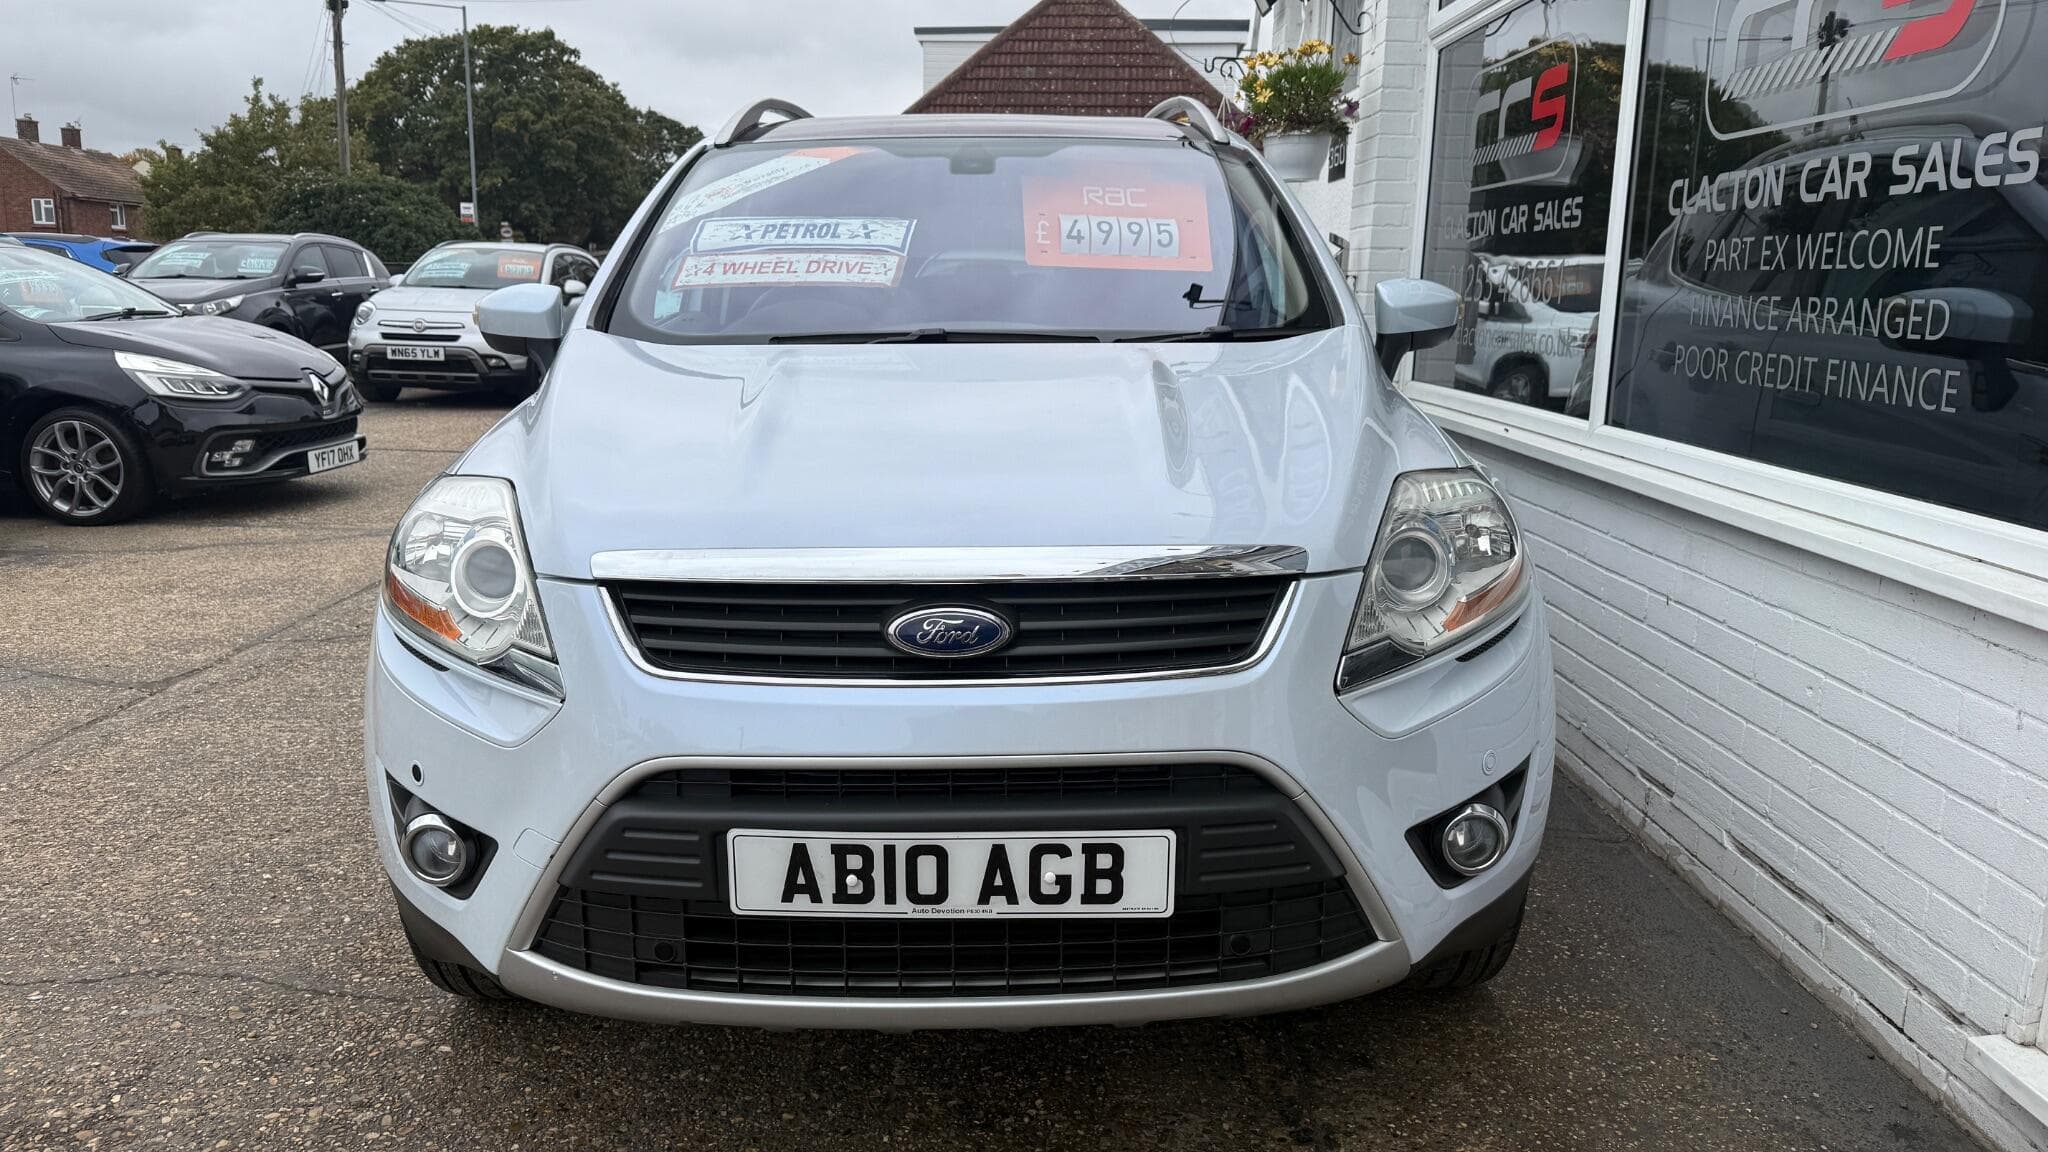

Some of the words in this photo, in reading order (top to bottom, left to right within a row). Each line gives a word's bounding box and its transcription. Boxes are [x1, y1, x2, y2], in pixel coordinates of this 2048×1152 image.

[1668, 164, 1787, 217] CLACTON
[1800, 151, 1872, 204] CAR
[1888, 127, 2045, 197] SALES
[760, 223, 841, 240] PETROL
[1065, 218, 1174, 249] 4995
[1444, 208, 1497, 240] CLACTON
[1501, 204, 1528, 235] CAR
[1533, 196, 1583, 232] SALES
[1704, 236, 1755, 272] PART
[1760, 234, 1790, 272] EX
[1796, 225, 1944, 270] WELCOME
[703, 262, 715, 276] 4
[722, 260, 799, 276] WHEEL
[805, 260, 872, 275] DRIVE
[1690, 294, 1781, 331] FINANCE
[1786, 296, 1951, 341] ARRANGED
[390, 346, 418, 358] WN65
[420, 347, 440, 359] YLW
[1674, 344, 1728, 383] POOR
[1735, 350, 1818, 393] CREDIT
[1824, 358, 1961, 414] FINANCE
[314, 449, 336, 469] YF17
[916, 618, 980, 645] Ford
[780, 842, 949, 905] AB10
[977, 842, 1126, 906] AGB
[911, 907, 930, 915] Auto
[931, 907, 965, 915] Devotion
